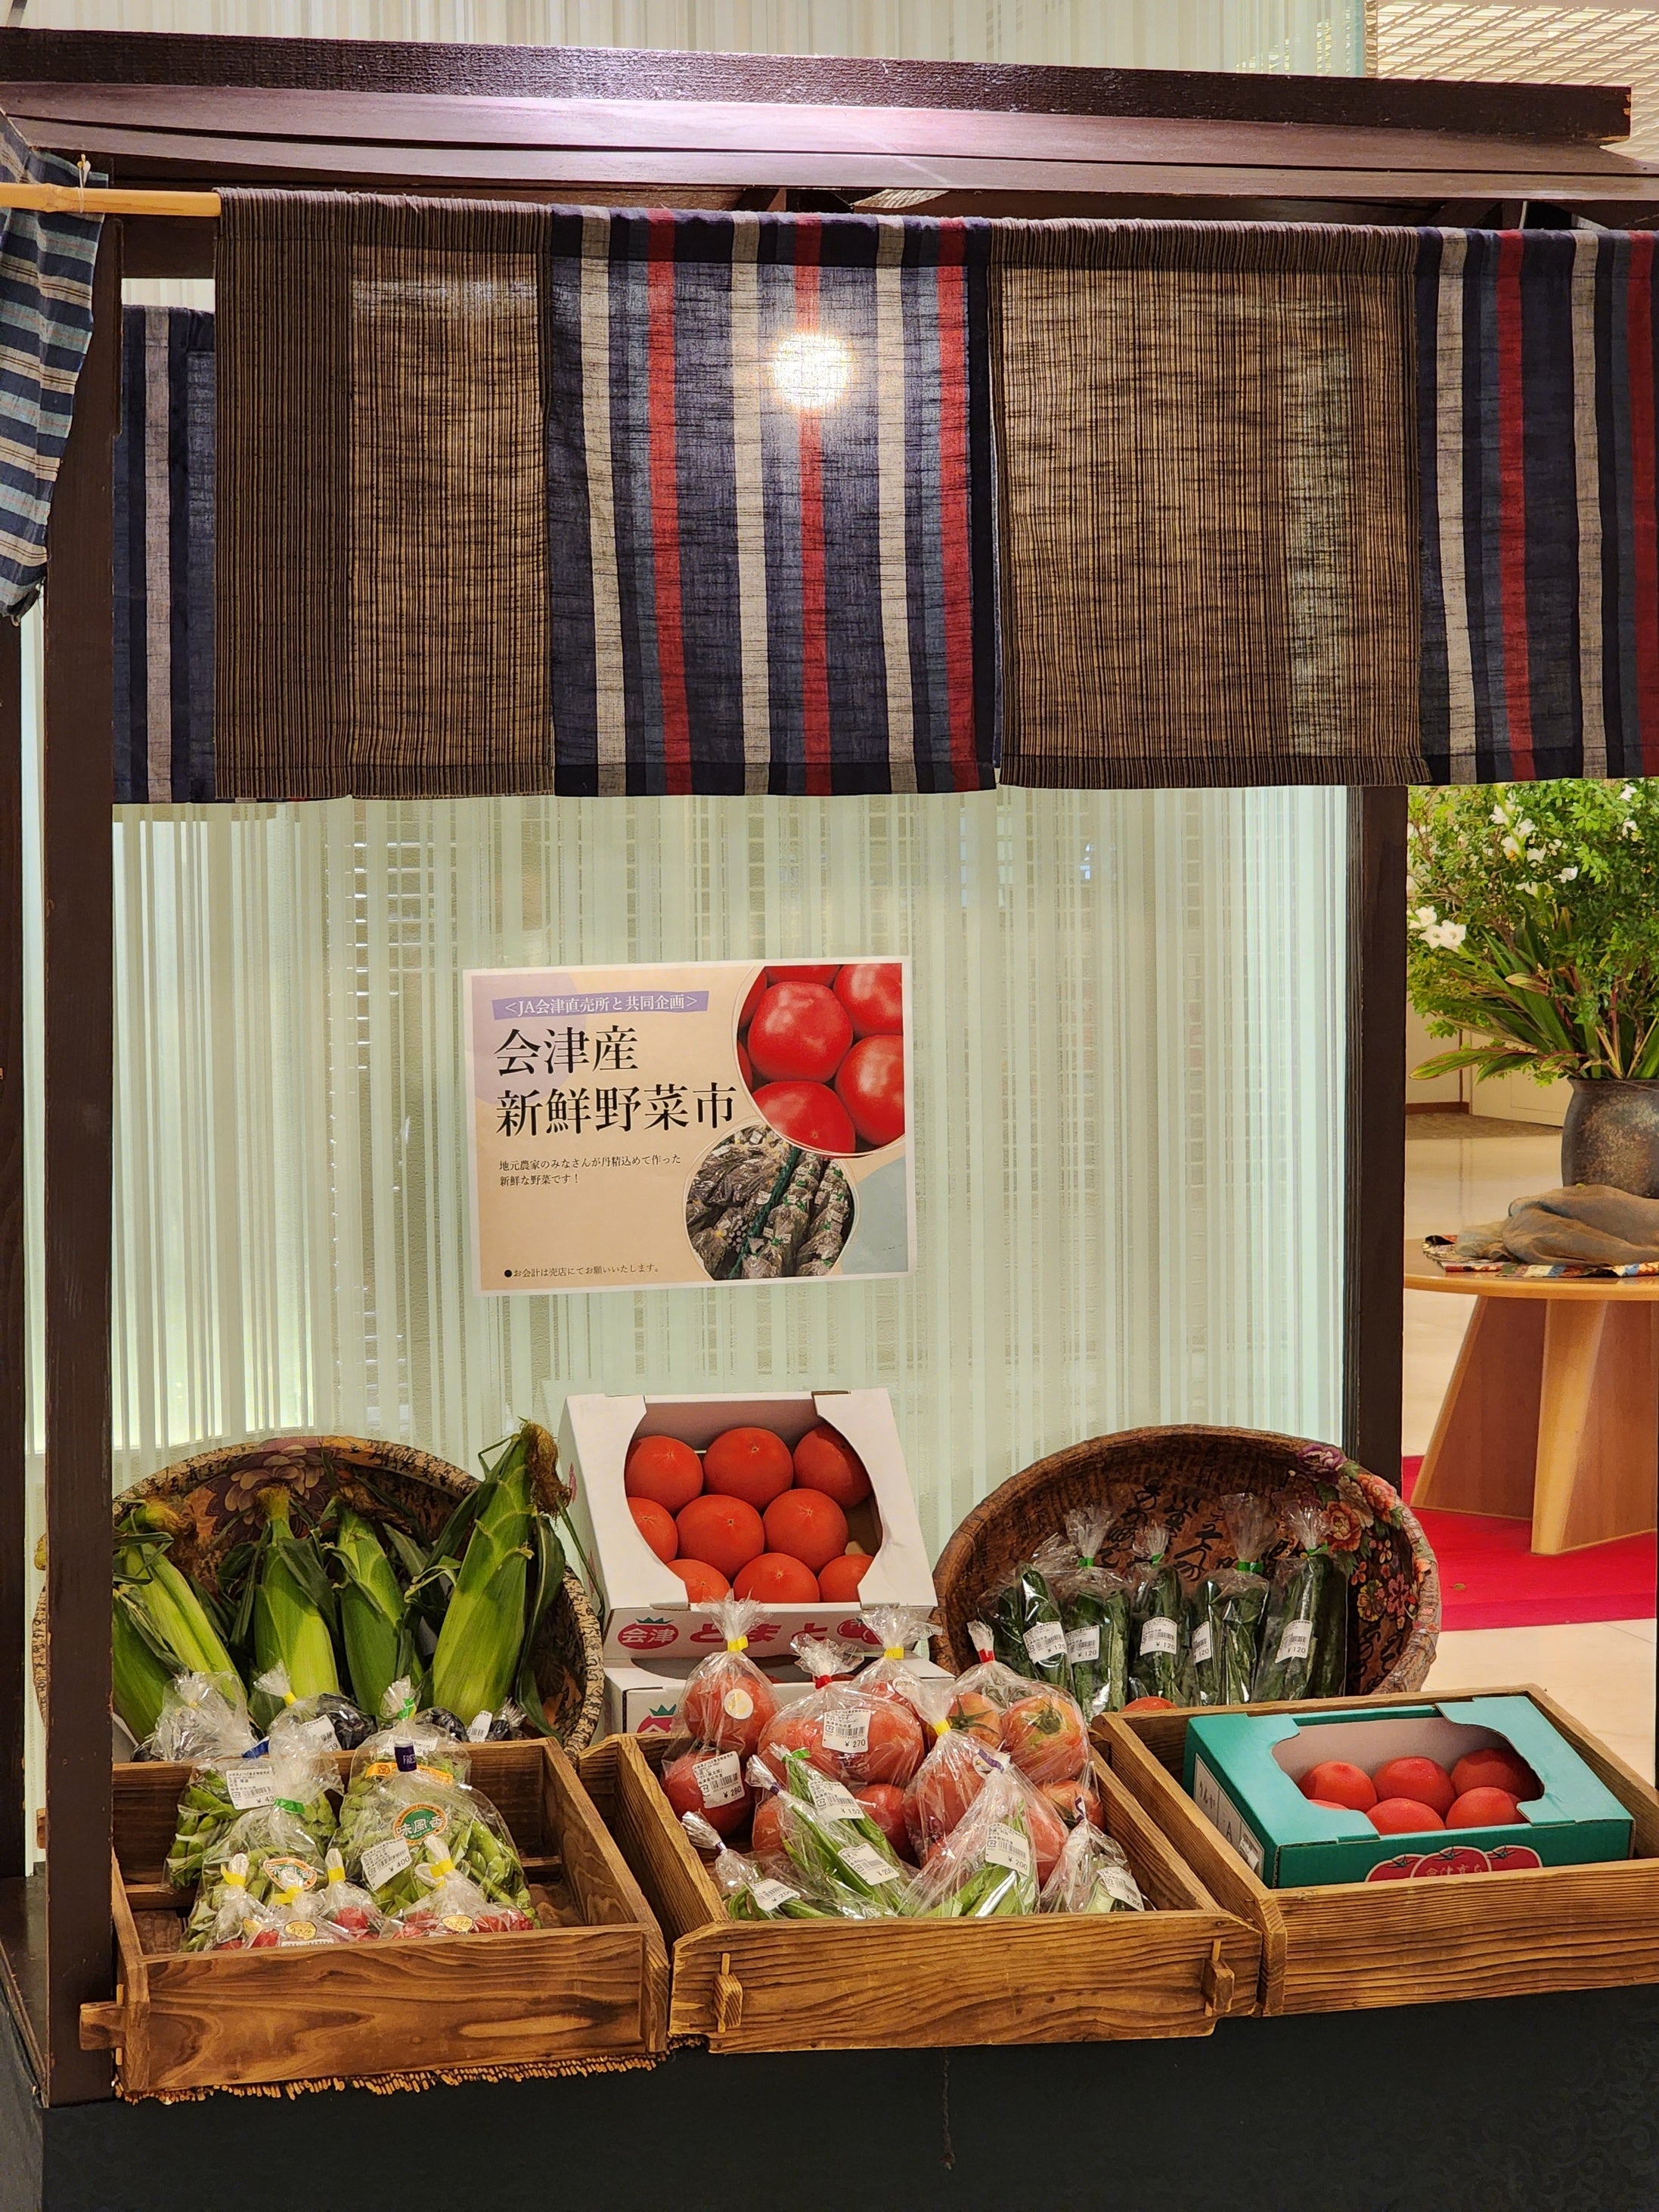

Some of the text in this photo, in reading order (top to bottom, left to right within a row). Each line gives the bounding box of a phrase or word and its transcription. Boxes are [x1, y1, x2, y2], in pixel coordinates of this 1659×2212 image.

[493, 1025, 639, 1076] 会津産
[495, 1081, 737, 1137] 新鮮野菜市
[499, 1154, 681, 1171] 地元農家のみなさんが丹精込めて作った
[500, 1174, 579, 1187] 新鮮な野菜です！
[622, 1628, 675, 1644] 会津
[853, 1739, 866, 1748] 270
[396, 1856, 410, 1867] 400
